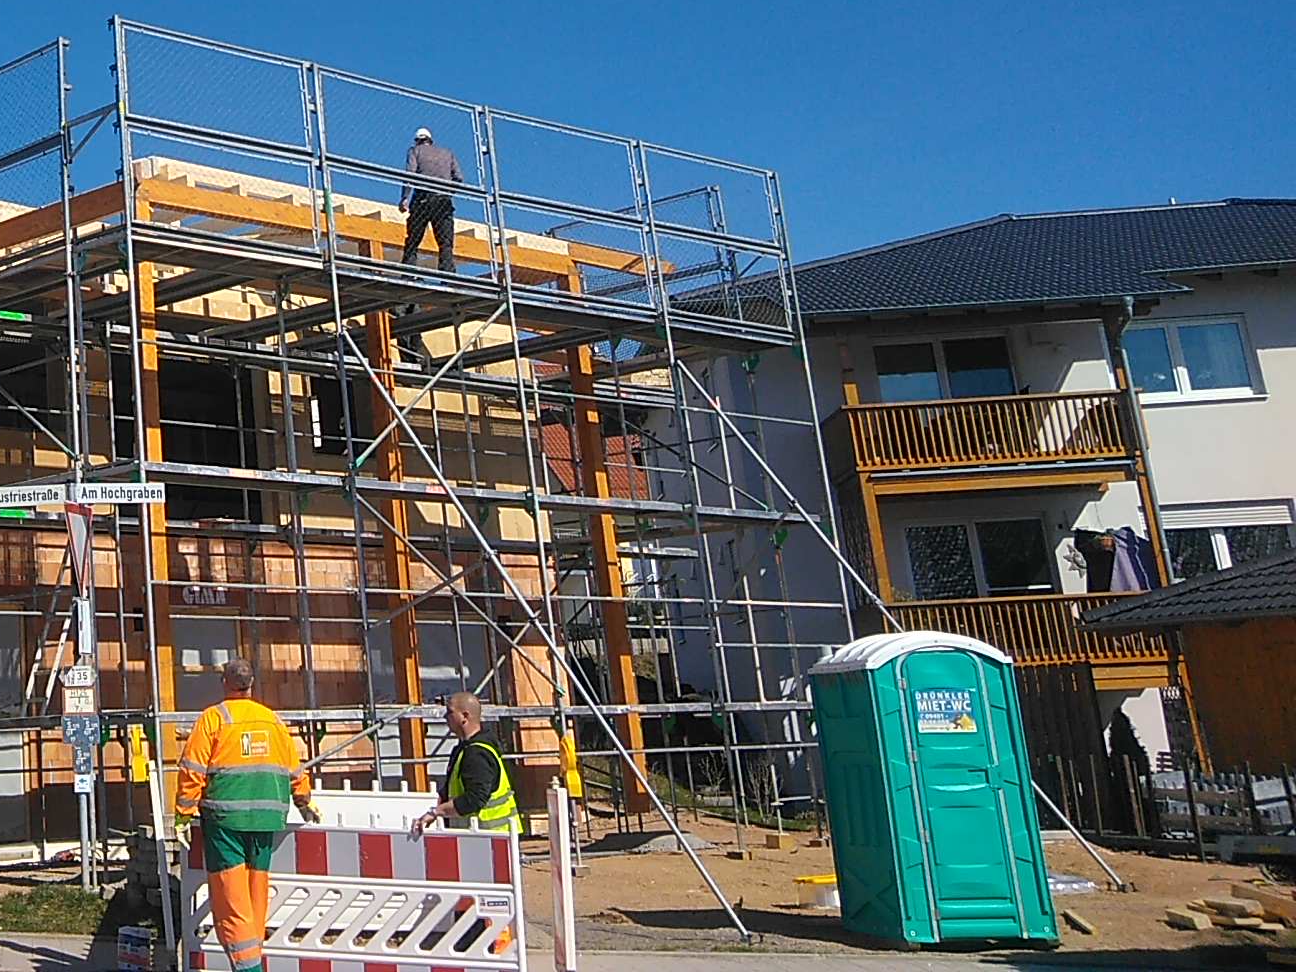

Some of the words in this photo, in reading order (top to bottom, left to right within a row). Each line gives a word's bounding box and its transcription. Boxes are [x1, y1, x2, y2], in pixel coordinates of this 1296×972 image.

[81, 486, 98, 499] Am
[100, 486, 163, 502] Hochgraben
[77, 671, 88, 681] 35
[917, 700, 972, 712] MIET-WC
